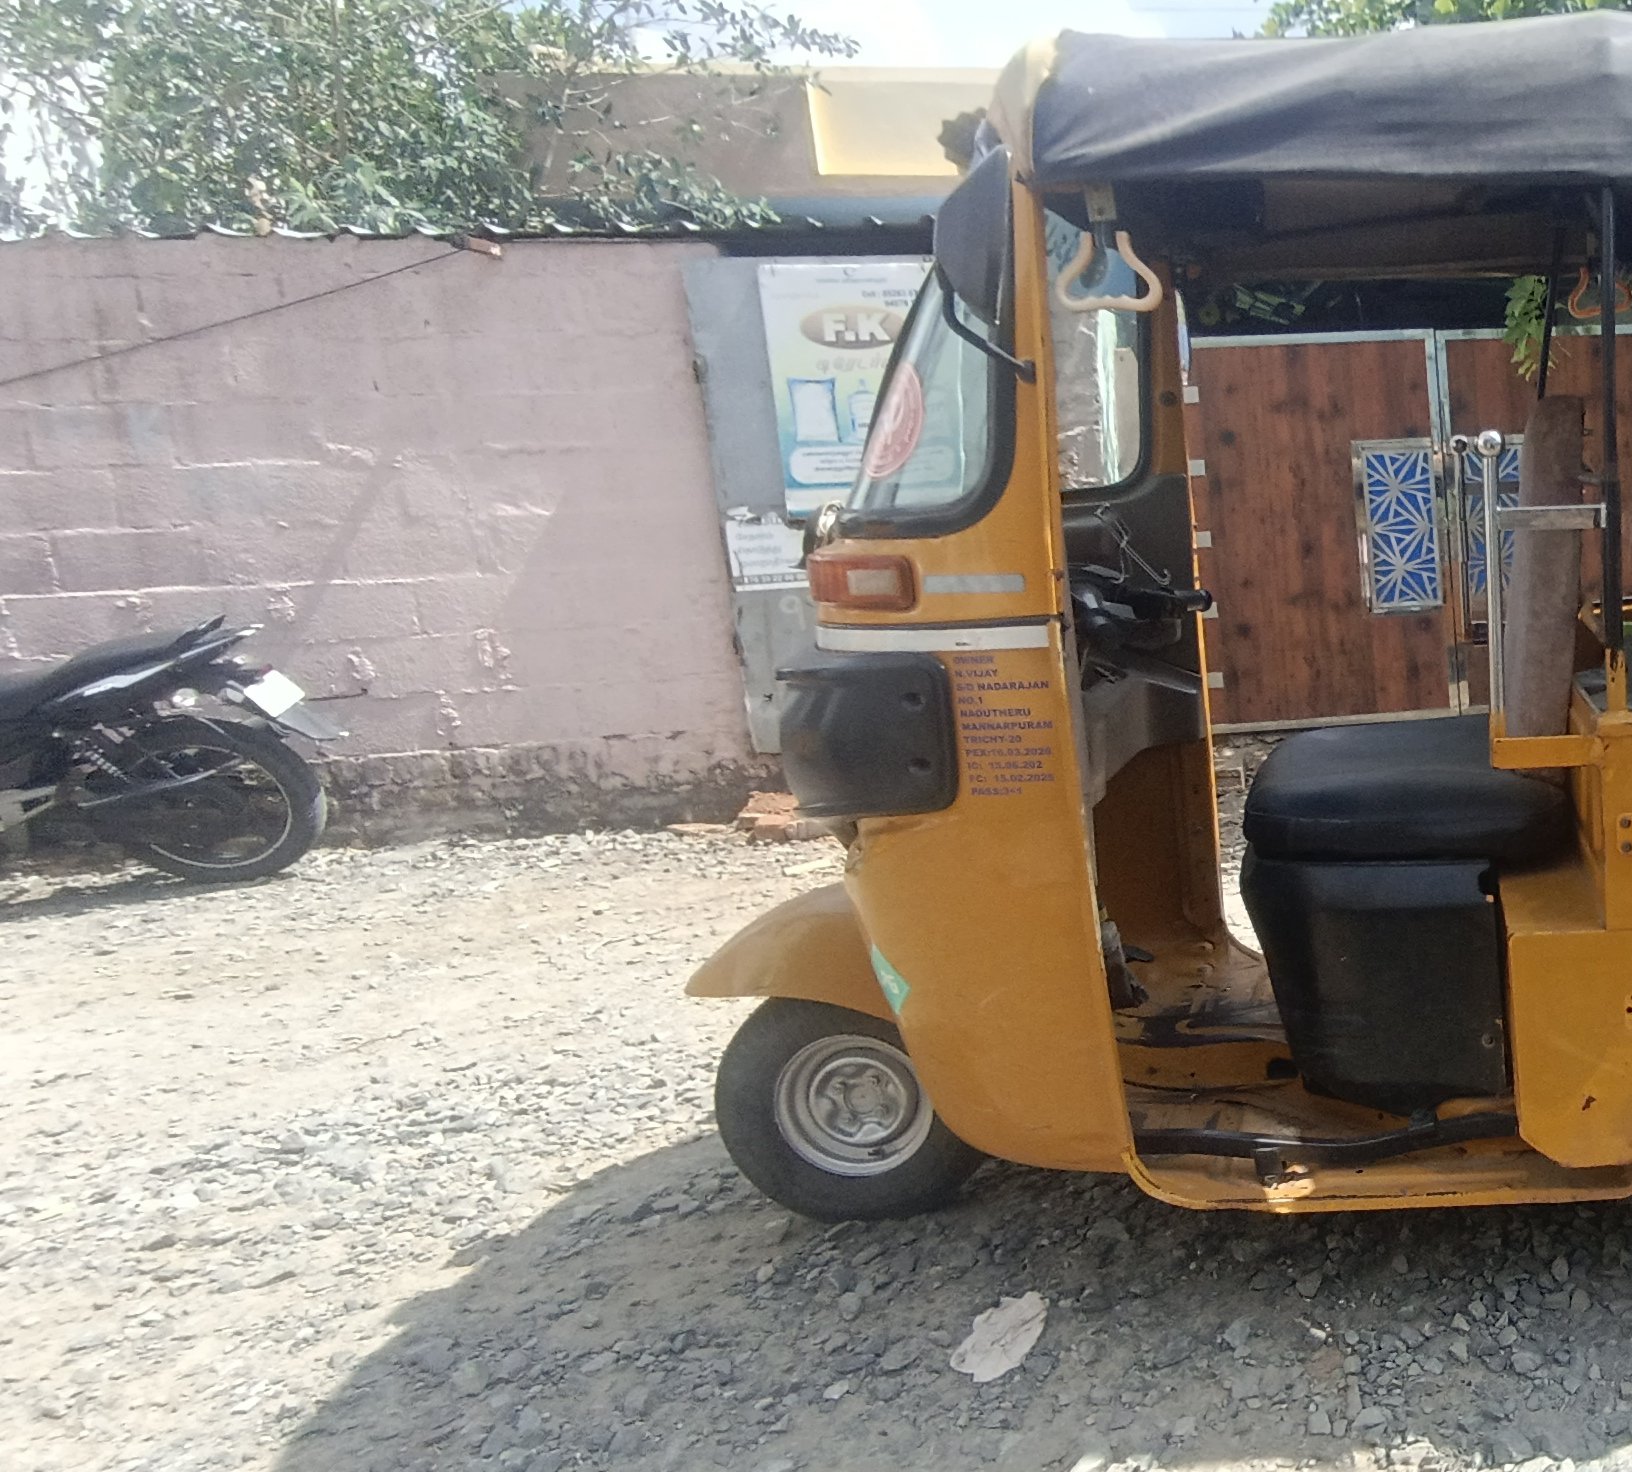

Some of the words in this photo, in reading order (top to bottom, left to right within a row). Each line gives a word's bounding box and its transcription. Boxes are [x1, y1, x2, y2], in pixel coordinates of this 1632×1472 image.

[822, 313, 891, 342] F.K
[953, 655, 995, 665] OWNER
[955, 669, 998, 678] N.VIJAY
[977, 681, 1049, 691] NADARAJAN
[960, 708, 1031, 718] NADUTHERU
[961, 720, 1054, 731] MANNARPURAM
